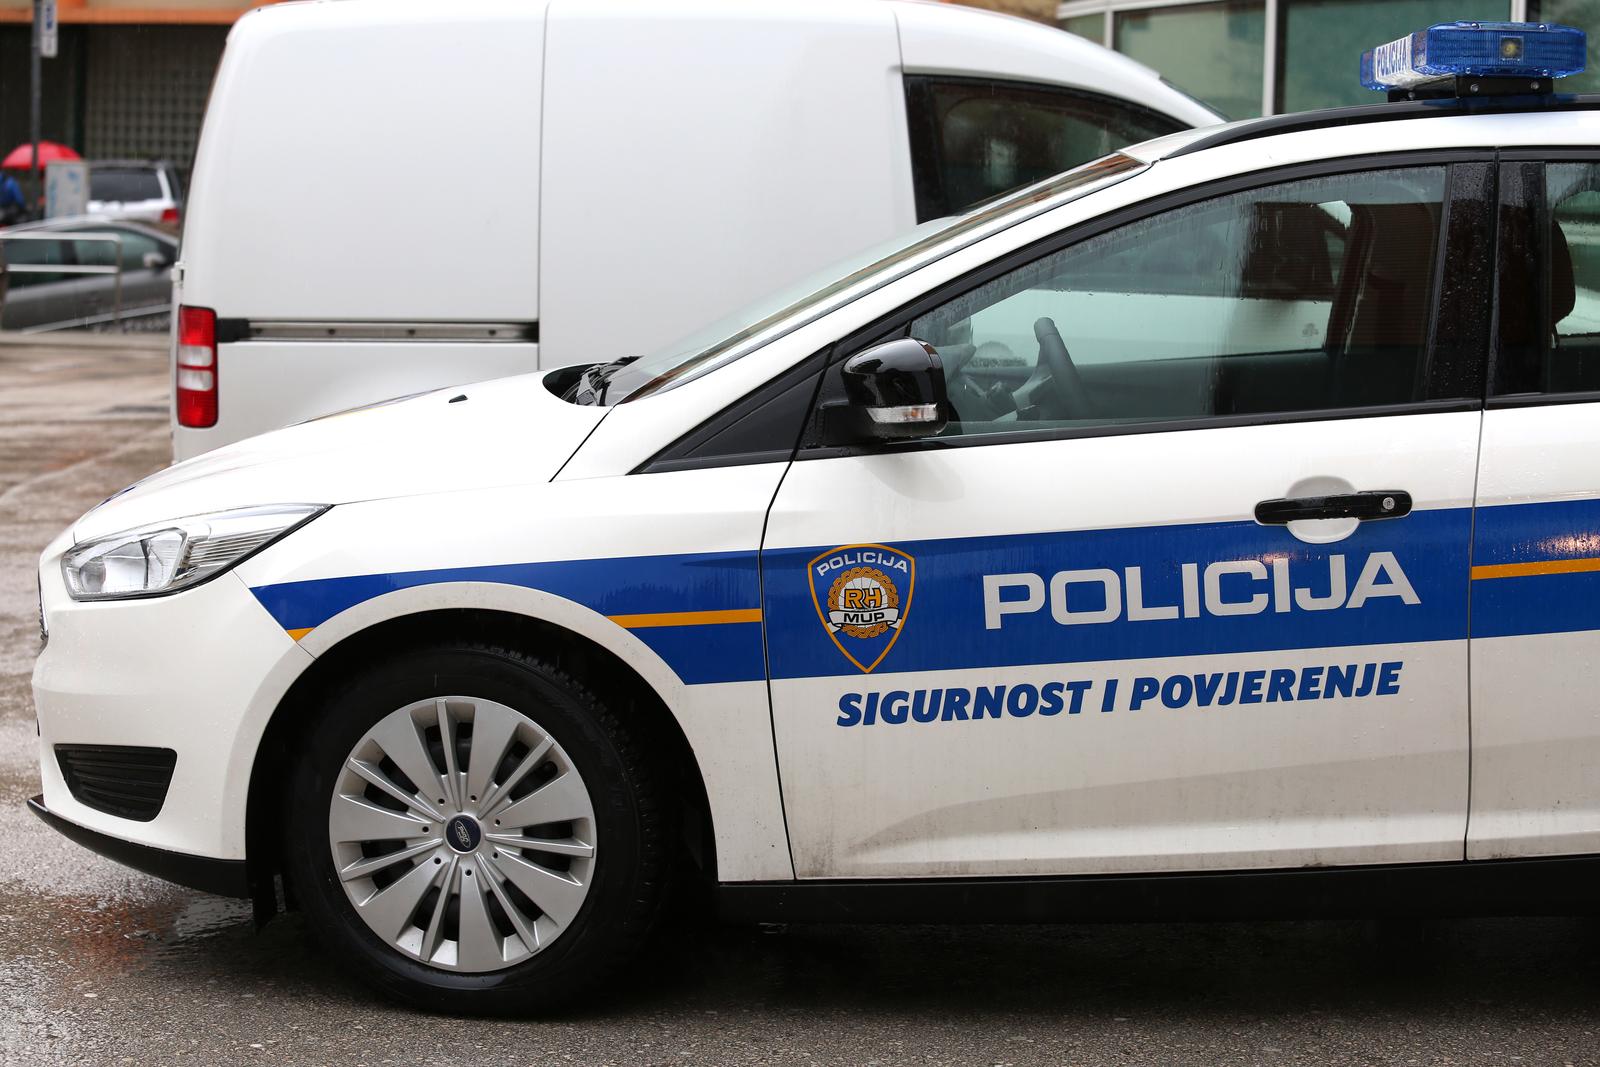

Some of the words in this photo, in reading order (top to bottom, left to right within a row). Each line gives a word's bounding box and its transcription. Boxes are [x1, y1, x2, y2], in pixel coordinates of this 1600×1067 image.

[1377, 38, 1407, 78] POLICIJA
[817, 552, 908, 576] POLICIJA
[843, 588, 883, 609] RH
[983, 552, 1421, 630] POLICIJA
[843, 612, 885, 623] MUP
[838, 681, 1092, 727] SIGURNOST
[1101, 679, 1118, 712] I
[1129, 661, 1403, 711] POVJERENJE
